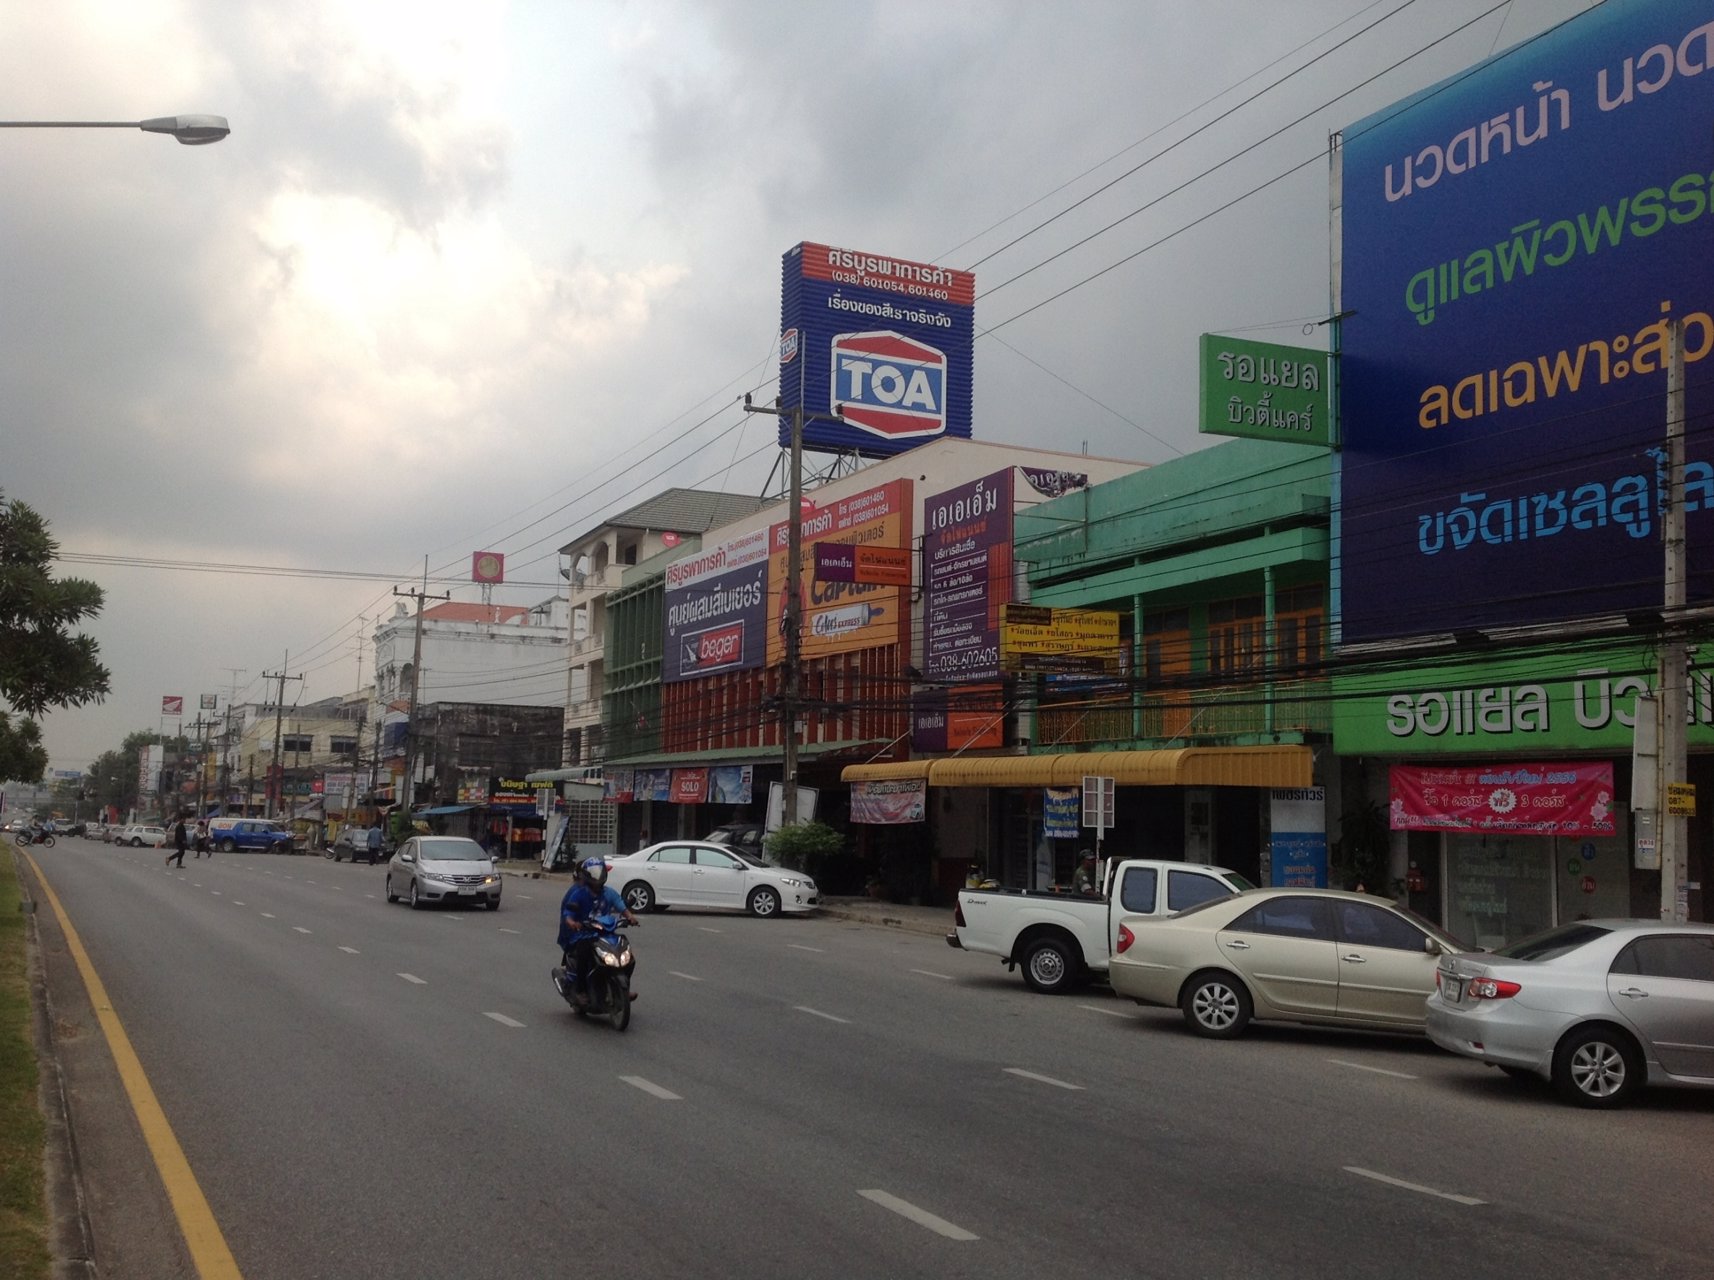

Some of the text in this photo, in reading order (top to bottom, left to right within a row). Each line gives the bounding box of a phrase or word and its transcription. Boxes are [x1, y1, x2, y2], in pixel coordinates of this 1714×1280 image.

[1384, 80, 1570, 202] นวดหน้า
[1406, 172, 1714, 326] ดูแลผิวพรร
[828, 288, 952, 329] เรื่องของสีเราจริงจัง
[841, 358, 937, 411] TOA
[1217, 351, 1320, 392] รอแยล
[1228, 391, 1314, 431] บิวตี้แคร์
[932, 480, 997, 531] เอเอเอ็ม
[701, 634, 739, 662] beger
[1386, 684, 1549, 735] รอแยล
[681, 782, 700, 793] SOLO
[1521, 794, 1529, 807] 3
